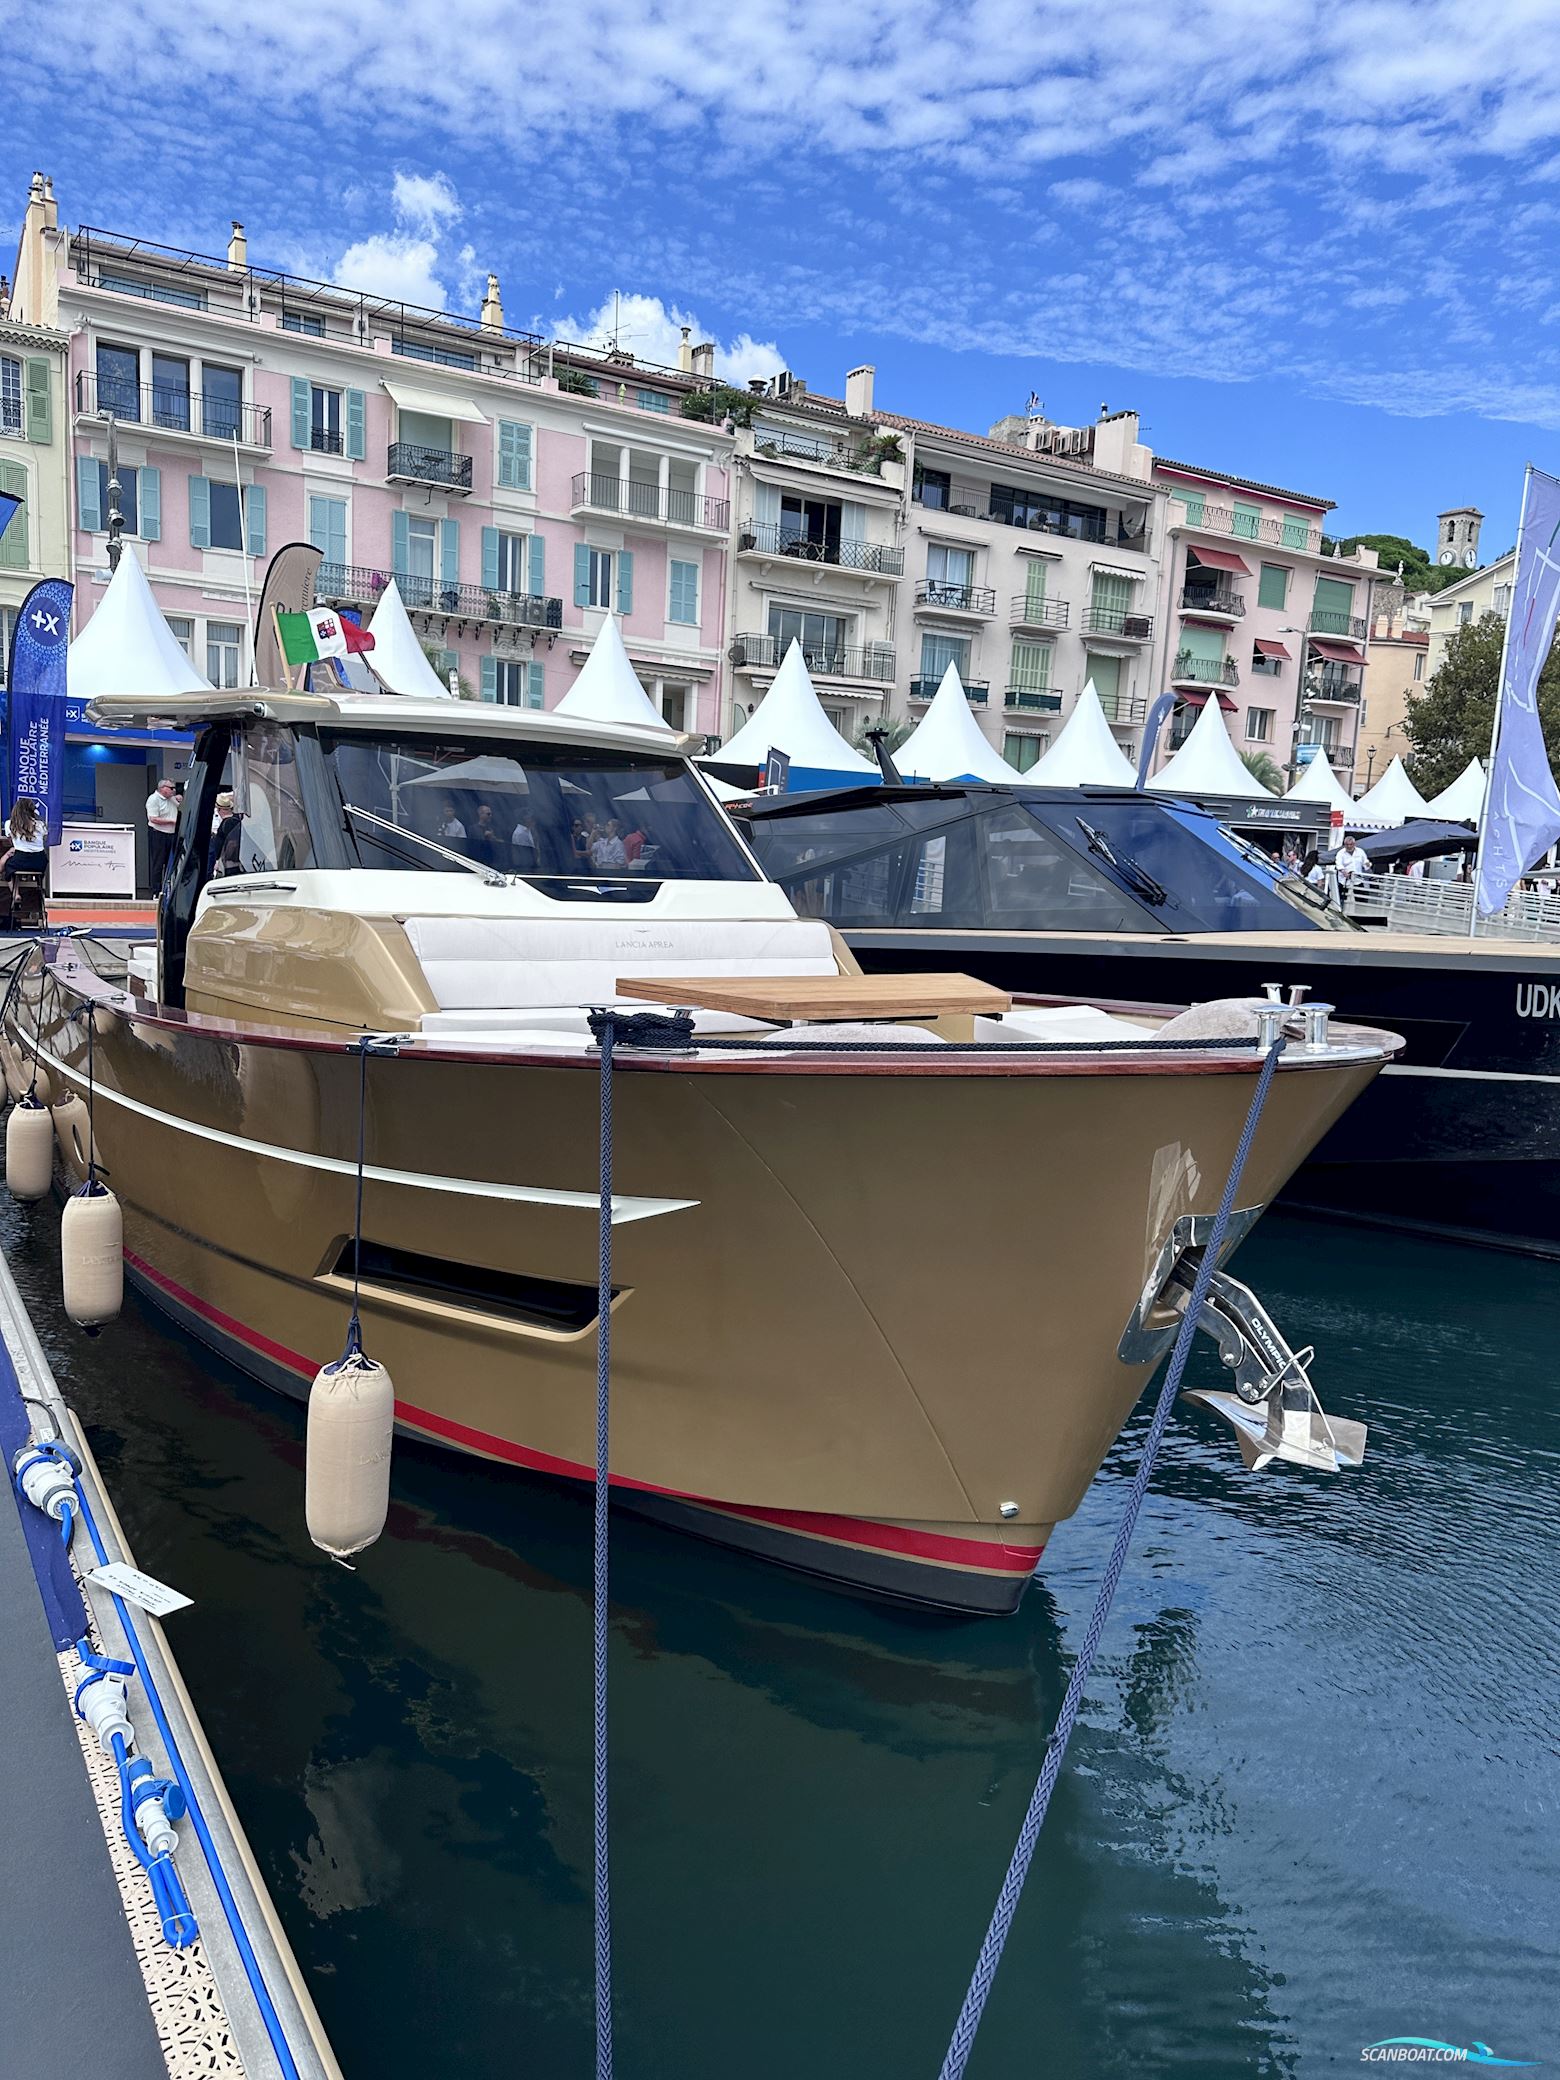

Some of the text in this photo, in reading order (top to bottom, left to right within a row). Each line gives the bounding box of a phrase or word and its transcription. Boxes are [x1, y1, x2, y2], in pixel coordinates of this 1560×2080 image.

[18, 737, 30, 793] BANQUE
[28, 720, 38, 794] POPULAIRE
[39, 717, 49, 795] MÉDITERRANÉE
[1516, 983, 1560, 1019] UDK
[1251, 1317, 1287, 1370] OLYMPIC
